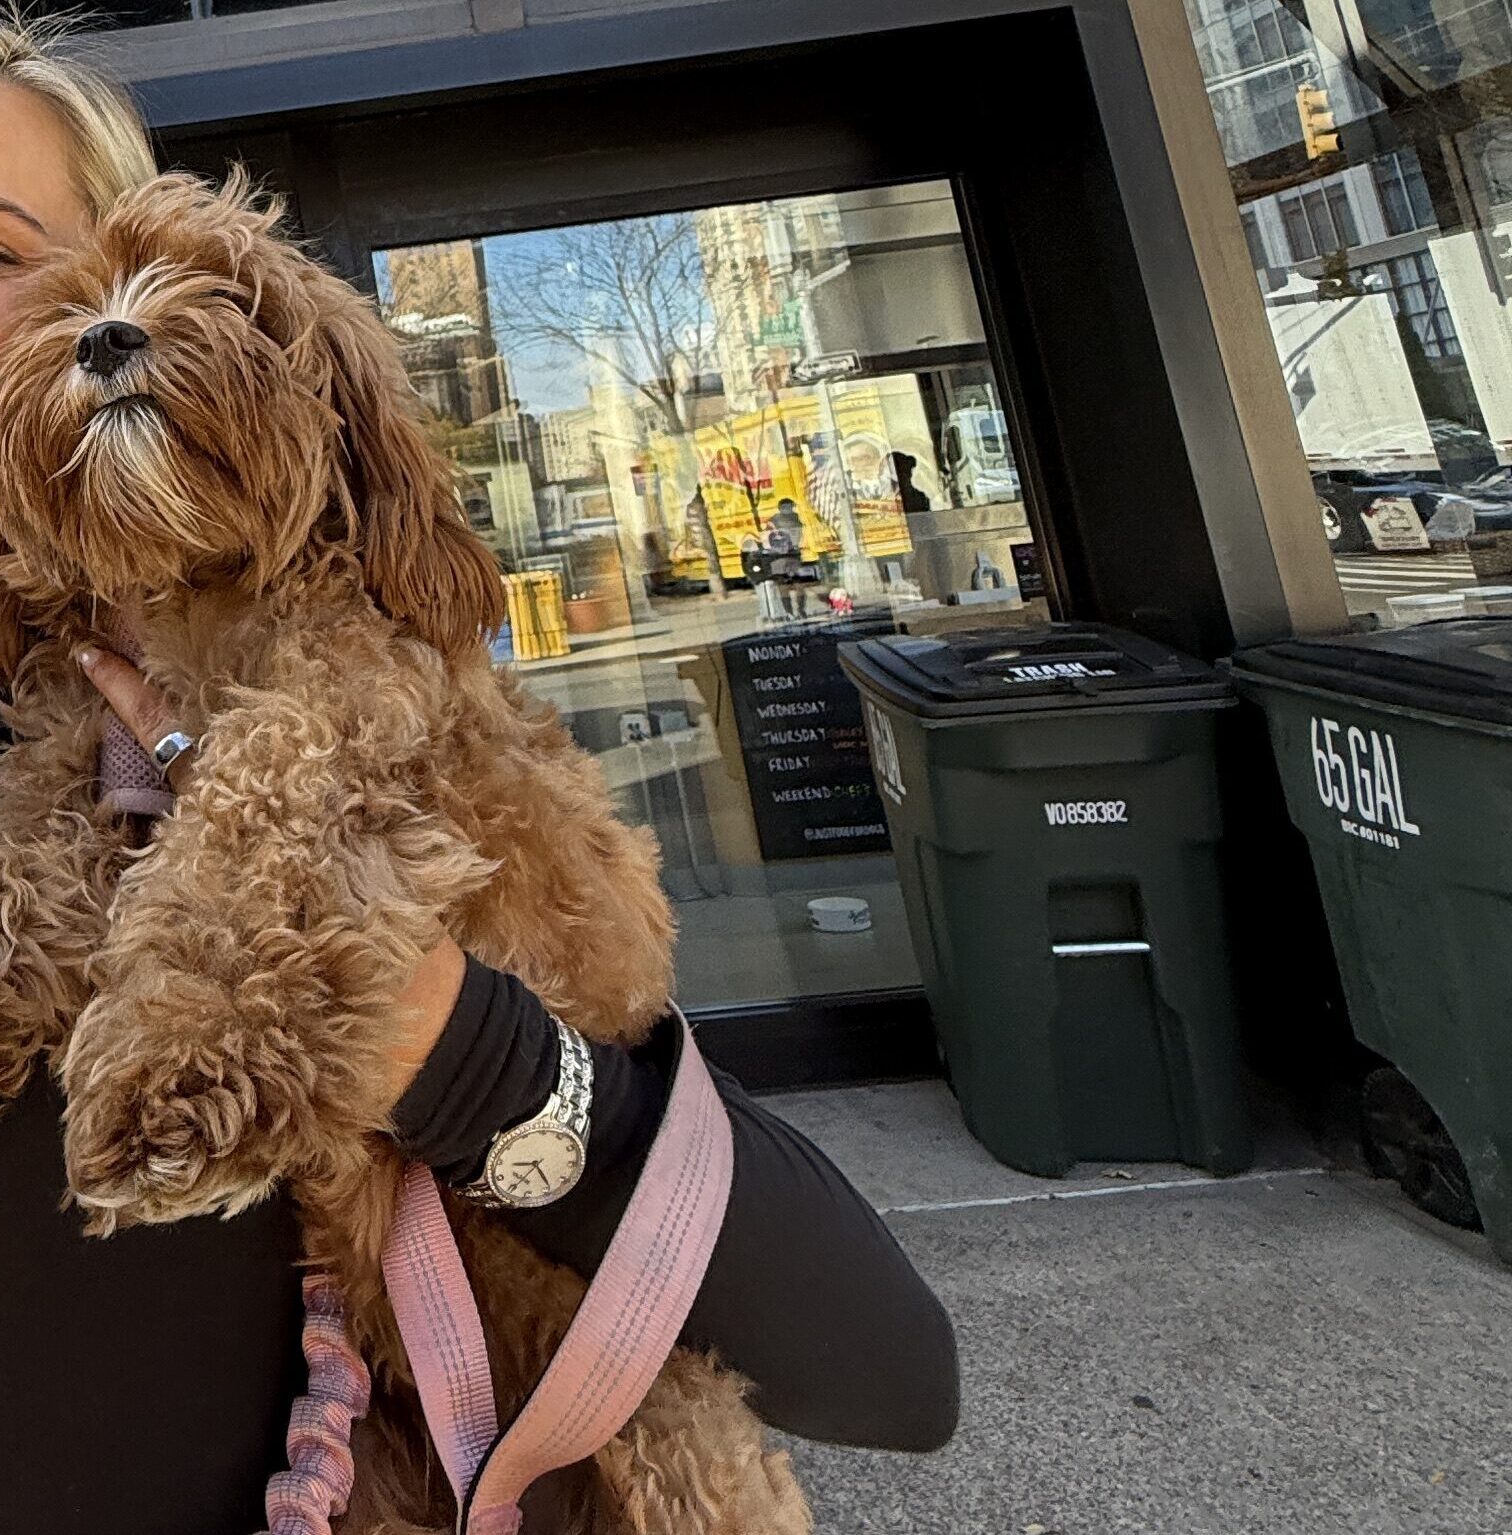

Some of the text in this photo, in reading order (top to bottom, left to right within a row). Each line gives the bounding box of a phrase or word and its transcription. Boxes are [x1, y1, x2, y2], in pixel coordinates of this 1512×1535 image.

[752, 674, 802, 692] TUESDAY
[757, 701, 827, 719] WEDNESDAY
[1311, 716, 1421, 835] 65 GAL
